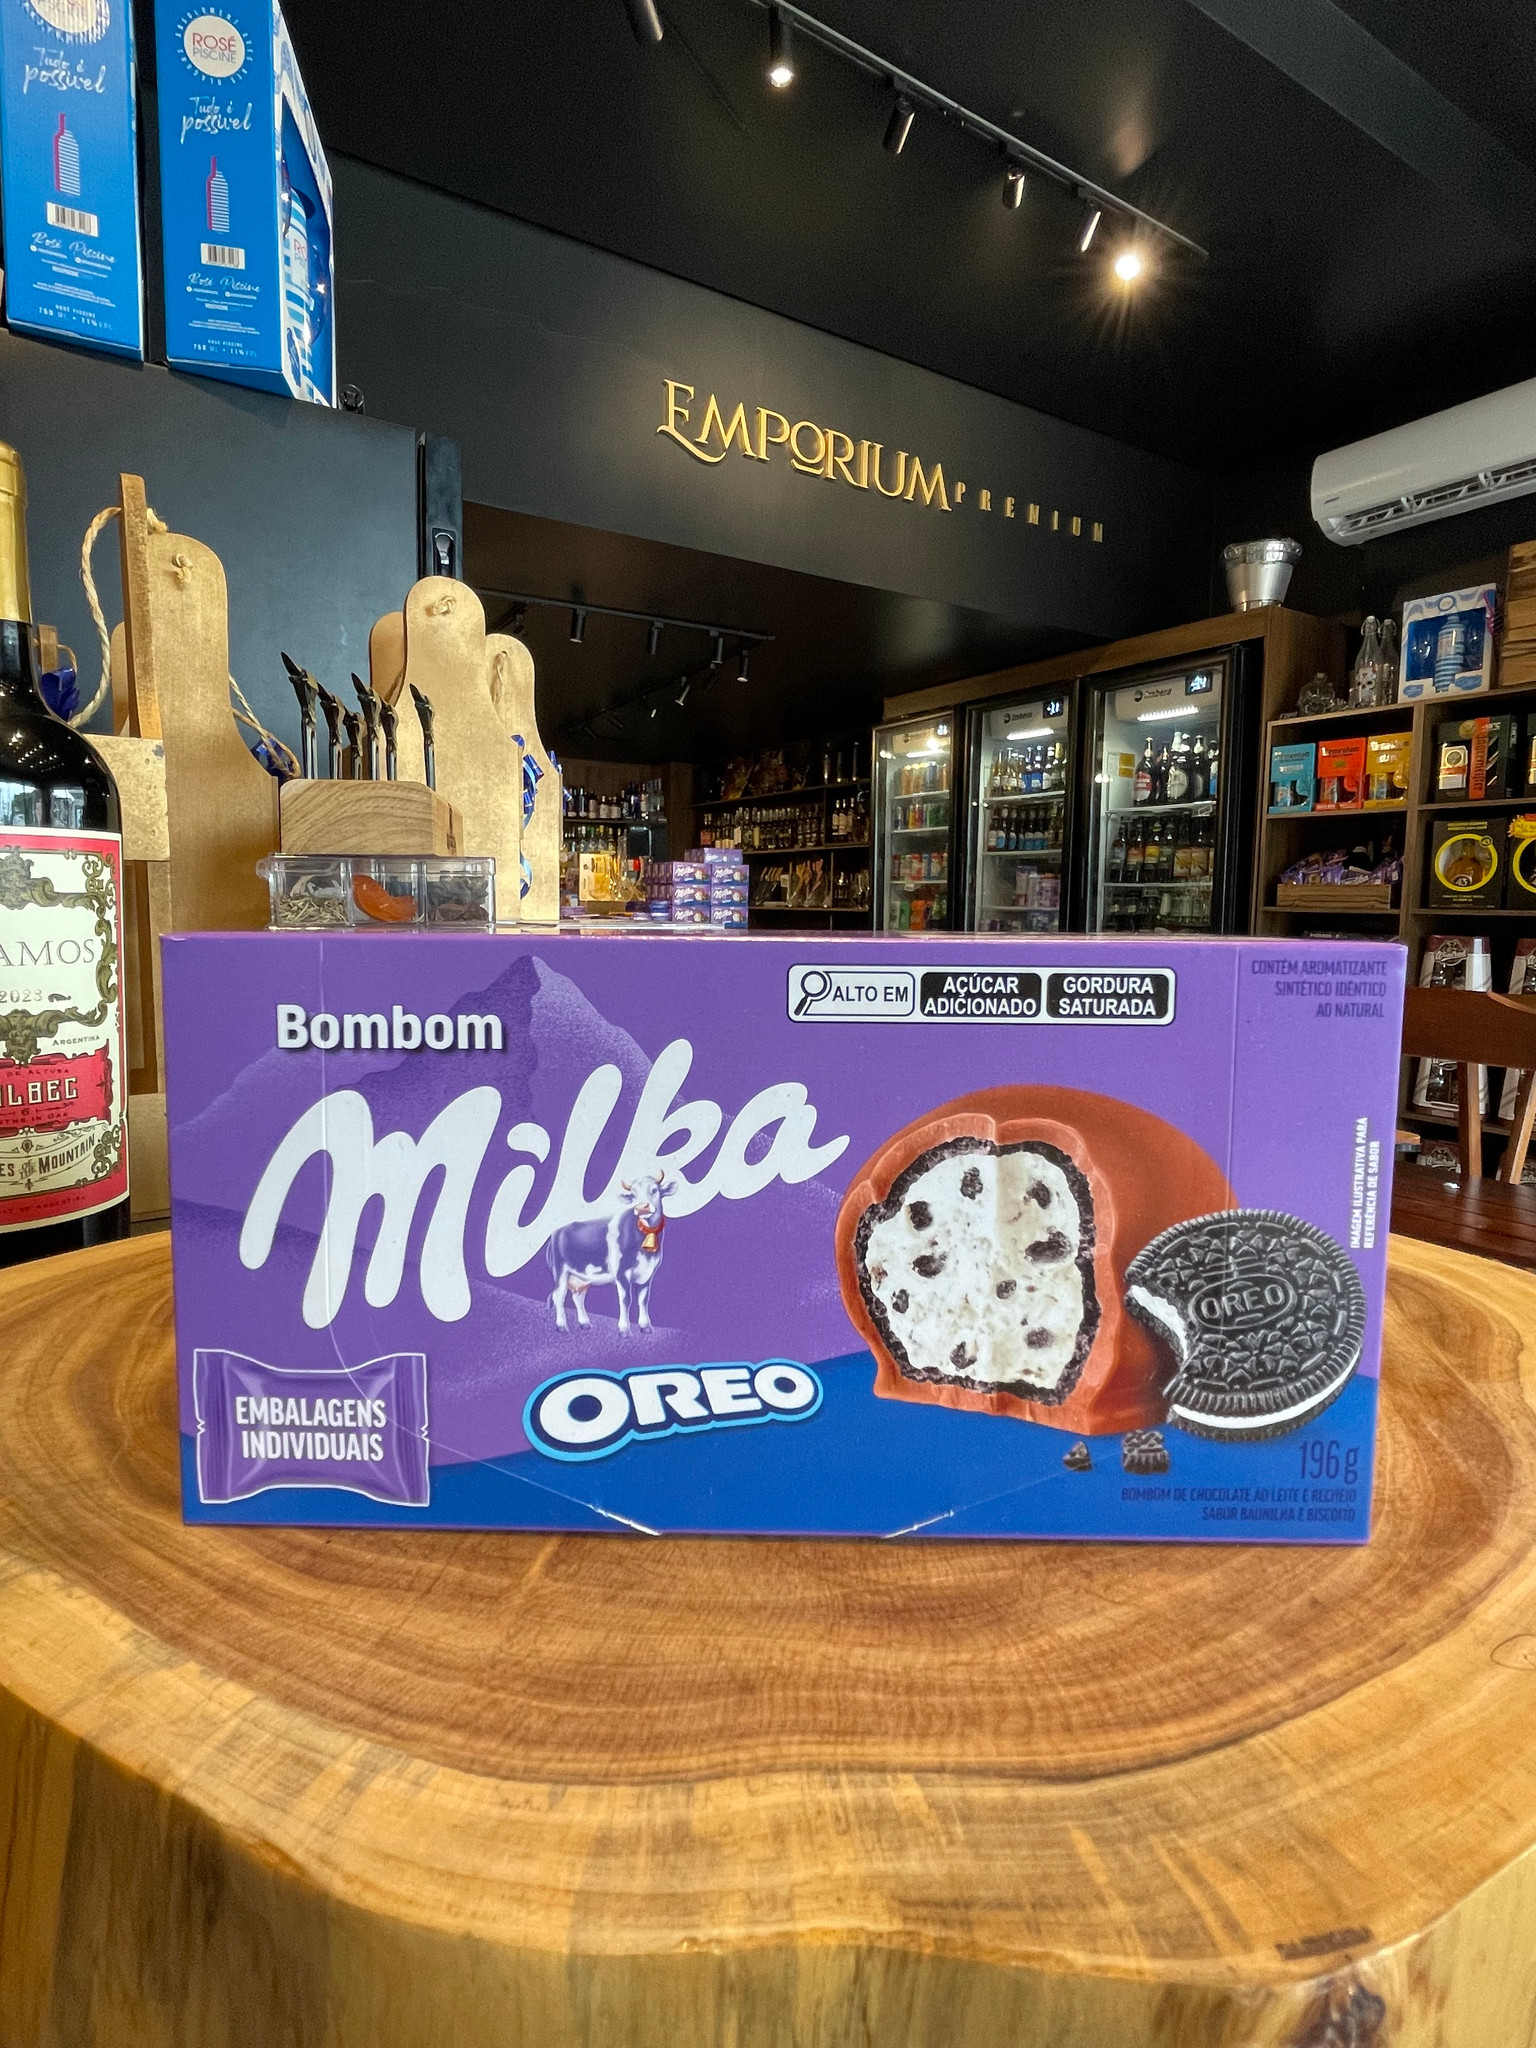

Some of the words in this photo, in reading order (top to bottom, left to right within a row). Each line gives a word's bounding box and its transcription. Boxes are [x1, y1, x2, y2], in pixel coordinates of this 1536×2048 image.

[192, 32, 236, 53] ROSÉ
[192, 46, 236, 64] PISCINE
[656, 378, 953, 512] EMPORIUM
[953, 480, 1104, 543] PREMIUM
[1251, 958, 1298, 975] CONTÉM
[1301, 960, 1388, 976] AROMATIZANTE
[832, 985, 878, 1003] ALTO
[883, 986, 909, 1003] EM
[942, 972, 1019, 999] AÇÚCAR
[1062, 976, 1154, 996] GORDURA
[1275, 979, 1333, 997] SINTÉTICO
[1335, 980, 1387, 998] IDÊNTICO
[923, 997, 1037, 1017] ADICIONADO
[1058, 998, 1157, 1016] SATURADA
[1315, 1002, 1333, 1018] AO
[1334, 1002, 1386, 1018] NATURAL
[52, 1034, 101, 1047] ARGENTINA
[276, 1003, 504, 1051] Bombom
[0, 1077, 77, 1107] LBEC
[1355, 1116, 1369, 1144] PARA
[38, 1133, 96, 1176] MOUNTAIN
[1367, 1141, 1381, 1174] SABOR
[238, 1038, 851, 1330] Milka
[1353, 1145, 1367, 1207] ILUSTRATIVA
[1367, 1175, 1379, 1189] DE
[1350, 1208, 1363, 1249] IMAGEM
[1200, 1284, 1285, 1321] OREO
[234, 1396, 387, 1429] EMBALAGENS
[538, 1363, 816, 1445] OREO
[241, 1430, 384, 1462] INDIVIDUAIS
[1121, 1487, 1171, 1501] BOMBOM
[1174, 1488, 1187, 1501] DE
[1190, 1487, 1251, 1502] CHOCOLATE
[1254, 1488, 1269, 1502] AO
[1271, 1488, 1299, 1502] LEITE
[1202, 1507, 1238, 1521] SABOR
